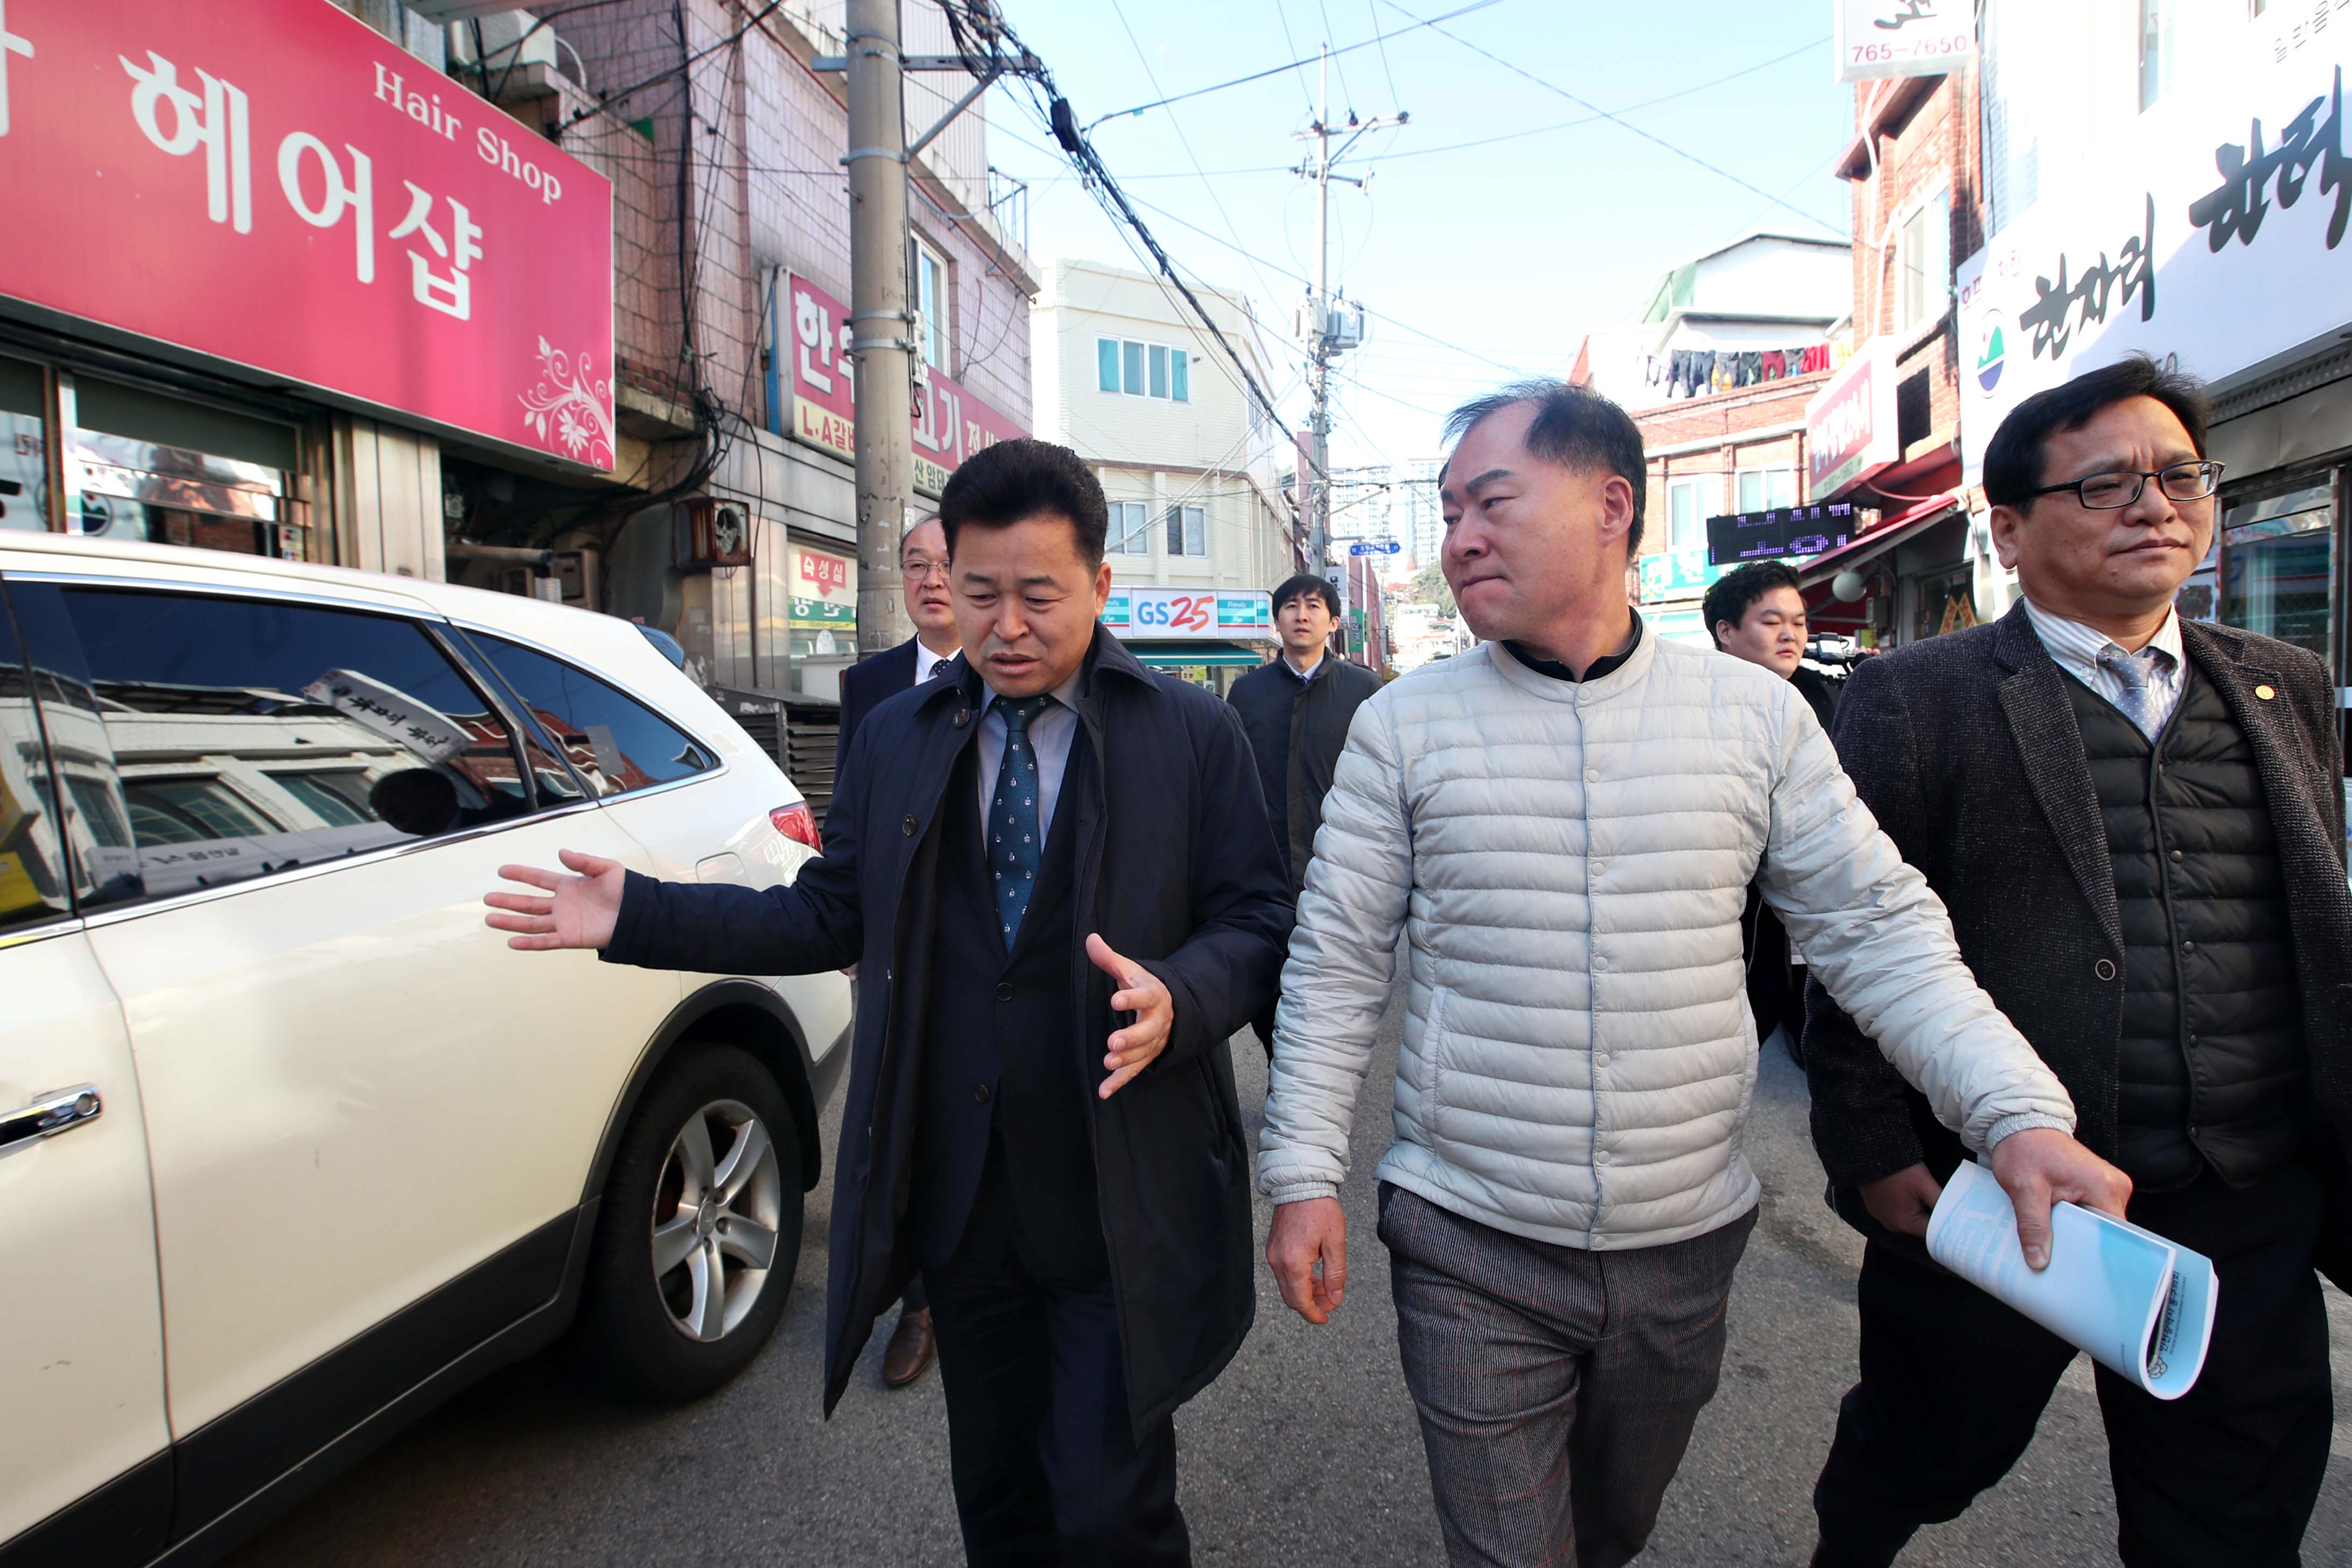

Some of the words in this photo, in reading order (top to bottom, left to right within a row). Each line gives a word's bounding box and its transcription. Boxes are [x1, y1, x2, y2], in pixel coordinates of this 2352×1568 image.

[1851, 34, 1968, 63] 765-7650
[373, 60, 463, 142] Hair
[477, 126, 563, 206] Shop
[117, 48, 484, 321] 헤어샵
[803, 556, 843, 583] 숙성실
[1137, 596, 1215, 632] GS25
